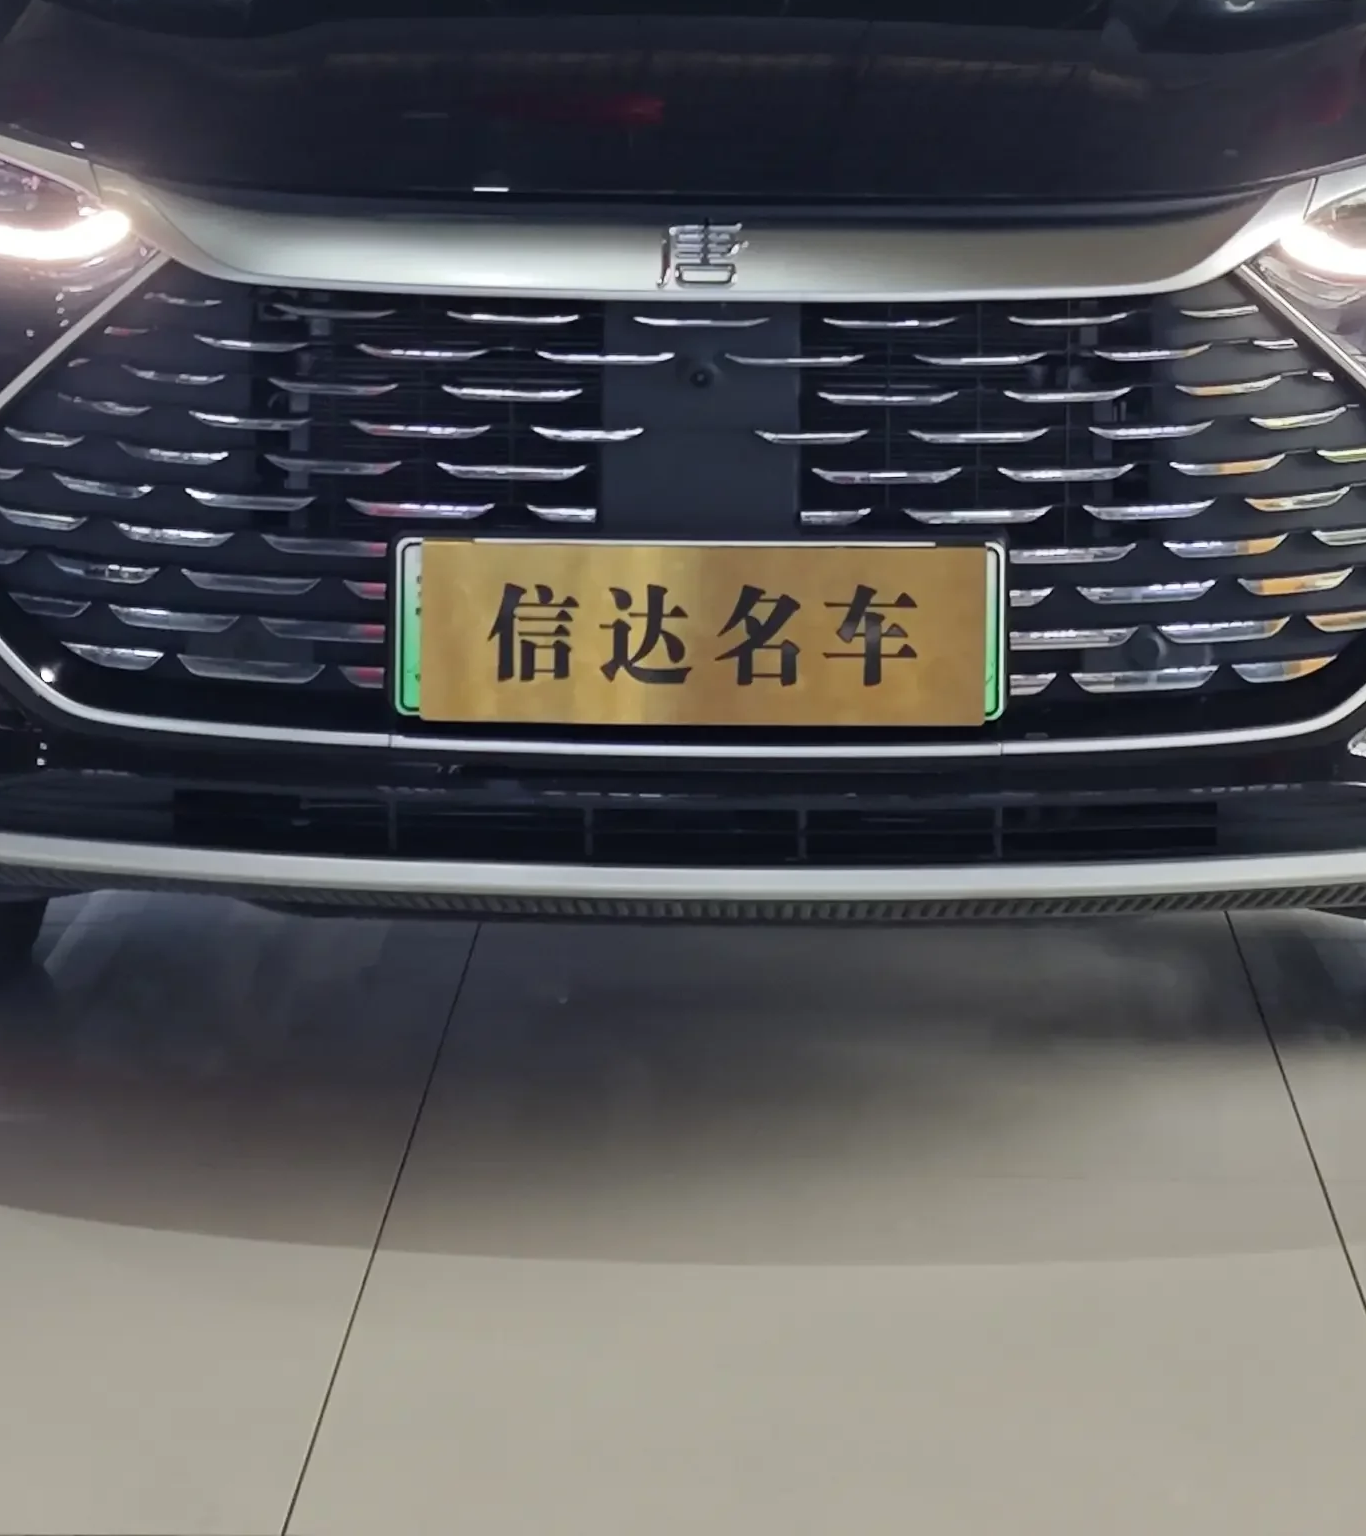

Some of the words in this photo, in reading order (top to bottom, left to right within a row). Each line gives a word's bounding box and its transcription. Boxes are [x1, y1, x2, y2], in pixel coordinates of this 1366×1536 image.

[656, 219, 749, 288] 唐
[487, 582, 919, 687] 信达名车
